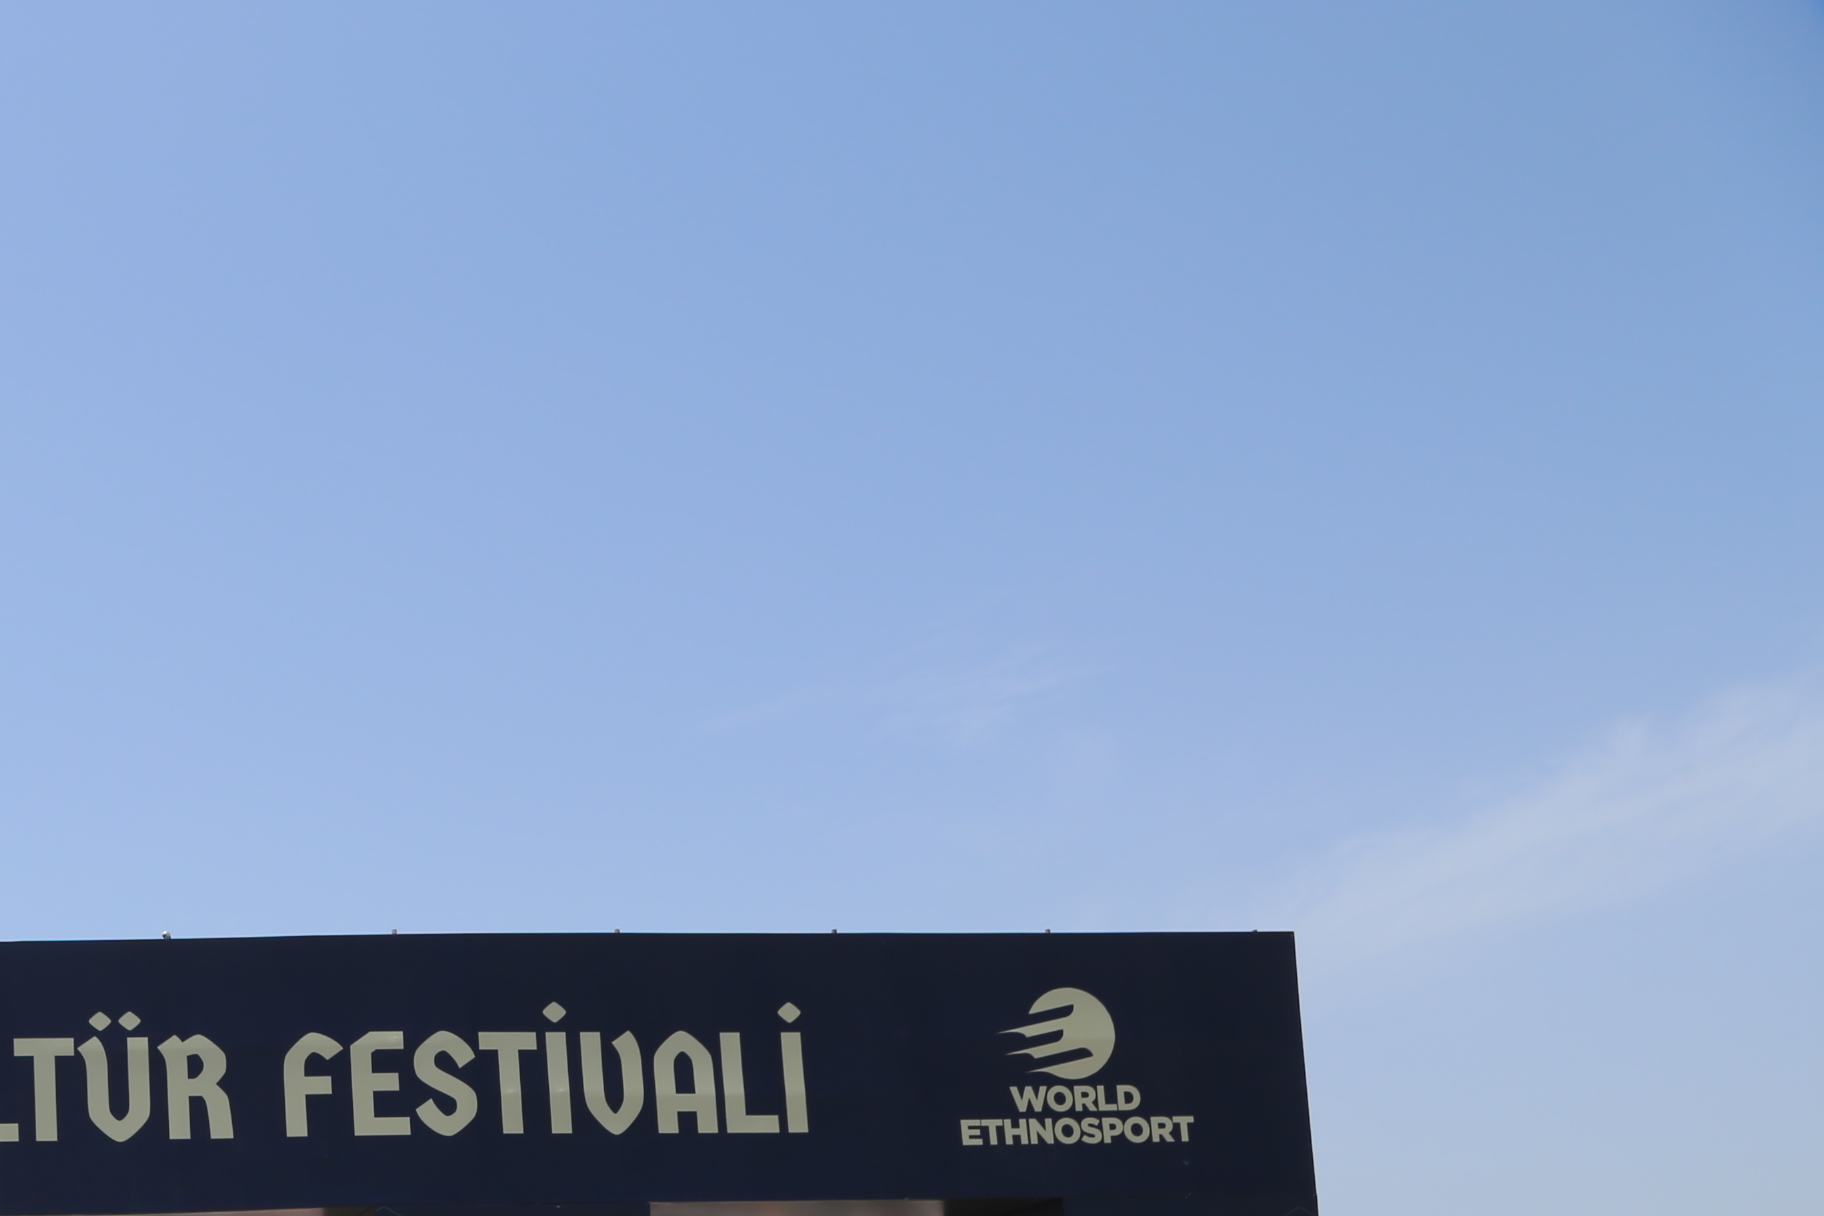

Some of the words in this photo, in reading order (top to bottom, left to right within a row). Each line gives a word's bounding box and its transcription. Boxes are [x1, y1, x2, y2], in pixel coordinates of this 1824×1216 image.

[283, 1001, 809, 1138] FESTİVALİ
[1009, 1084, 1142, 1113] WORLD
[959, 1115, 1195, 1146] ETHNOSPORT
